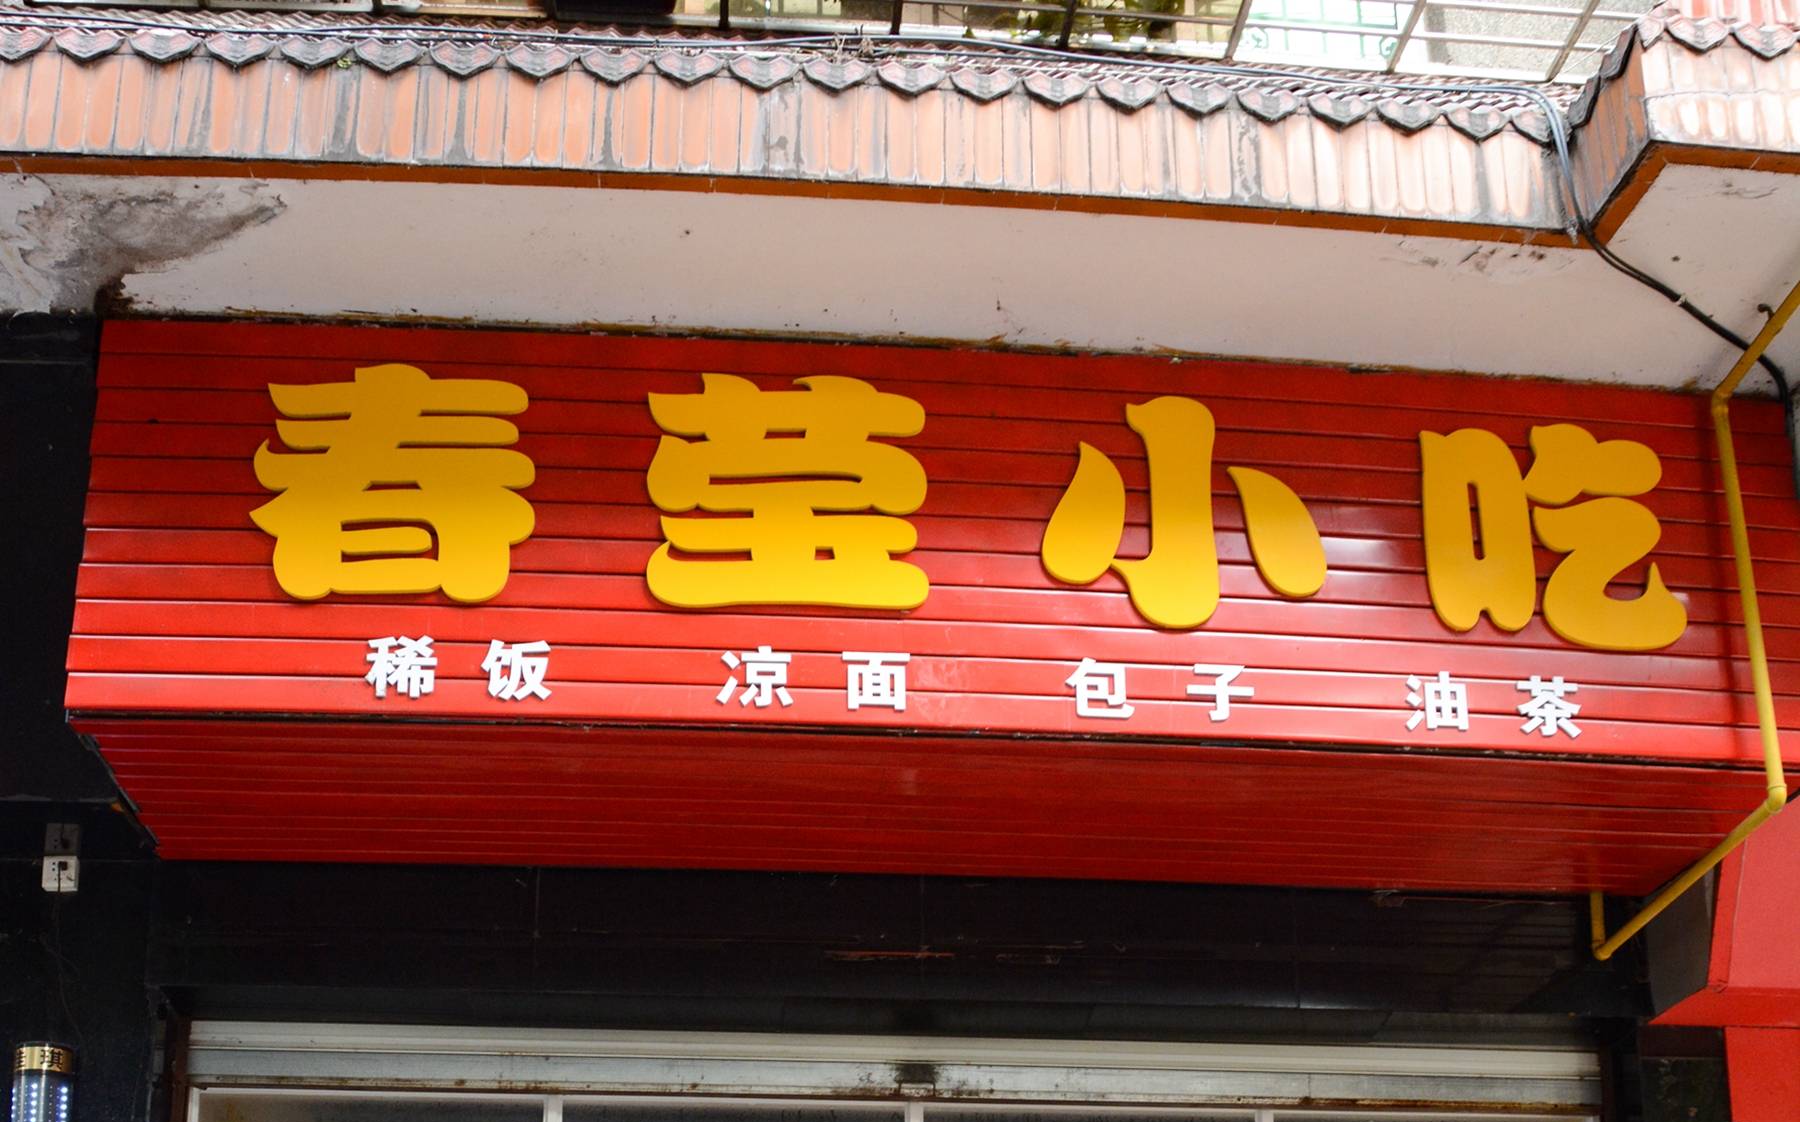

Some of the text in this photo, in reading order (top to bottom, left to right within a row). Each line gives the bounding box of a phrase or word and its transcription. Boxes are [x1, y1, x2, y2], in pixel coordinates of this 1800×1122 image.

[249, 362, 1688, 651] 春莹小吃
[365, 635, 1583, 740] 稀饭 凉面 包子 油茶
